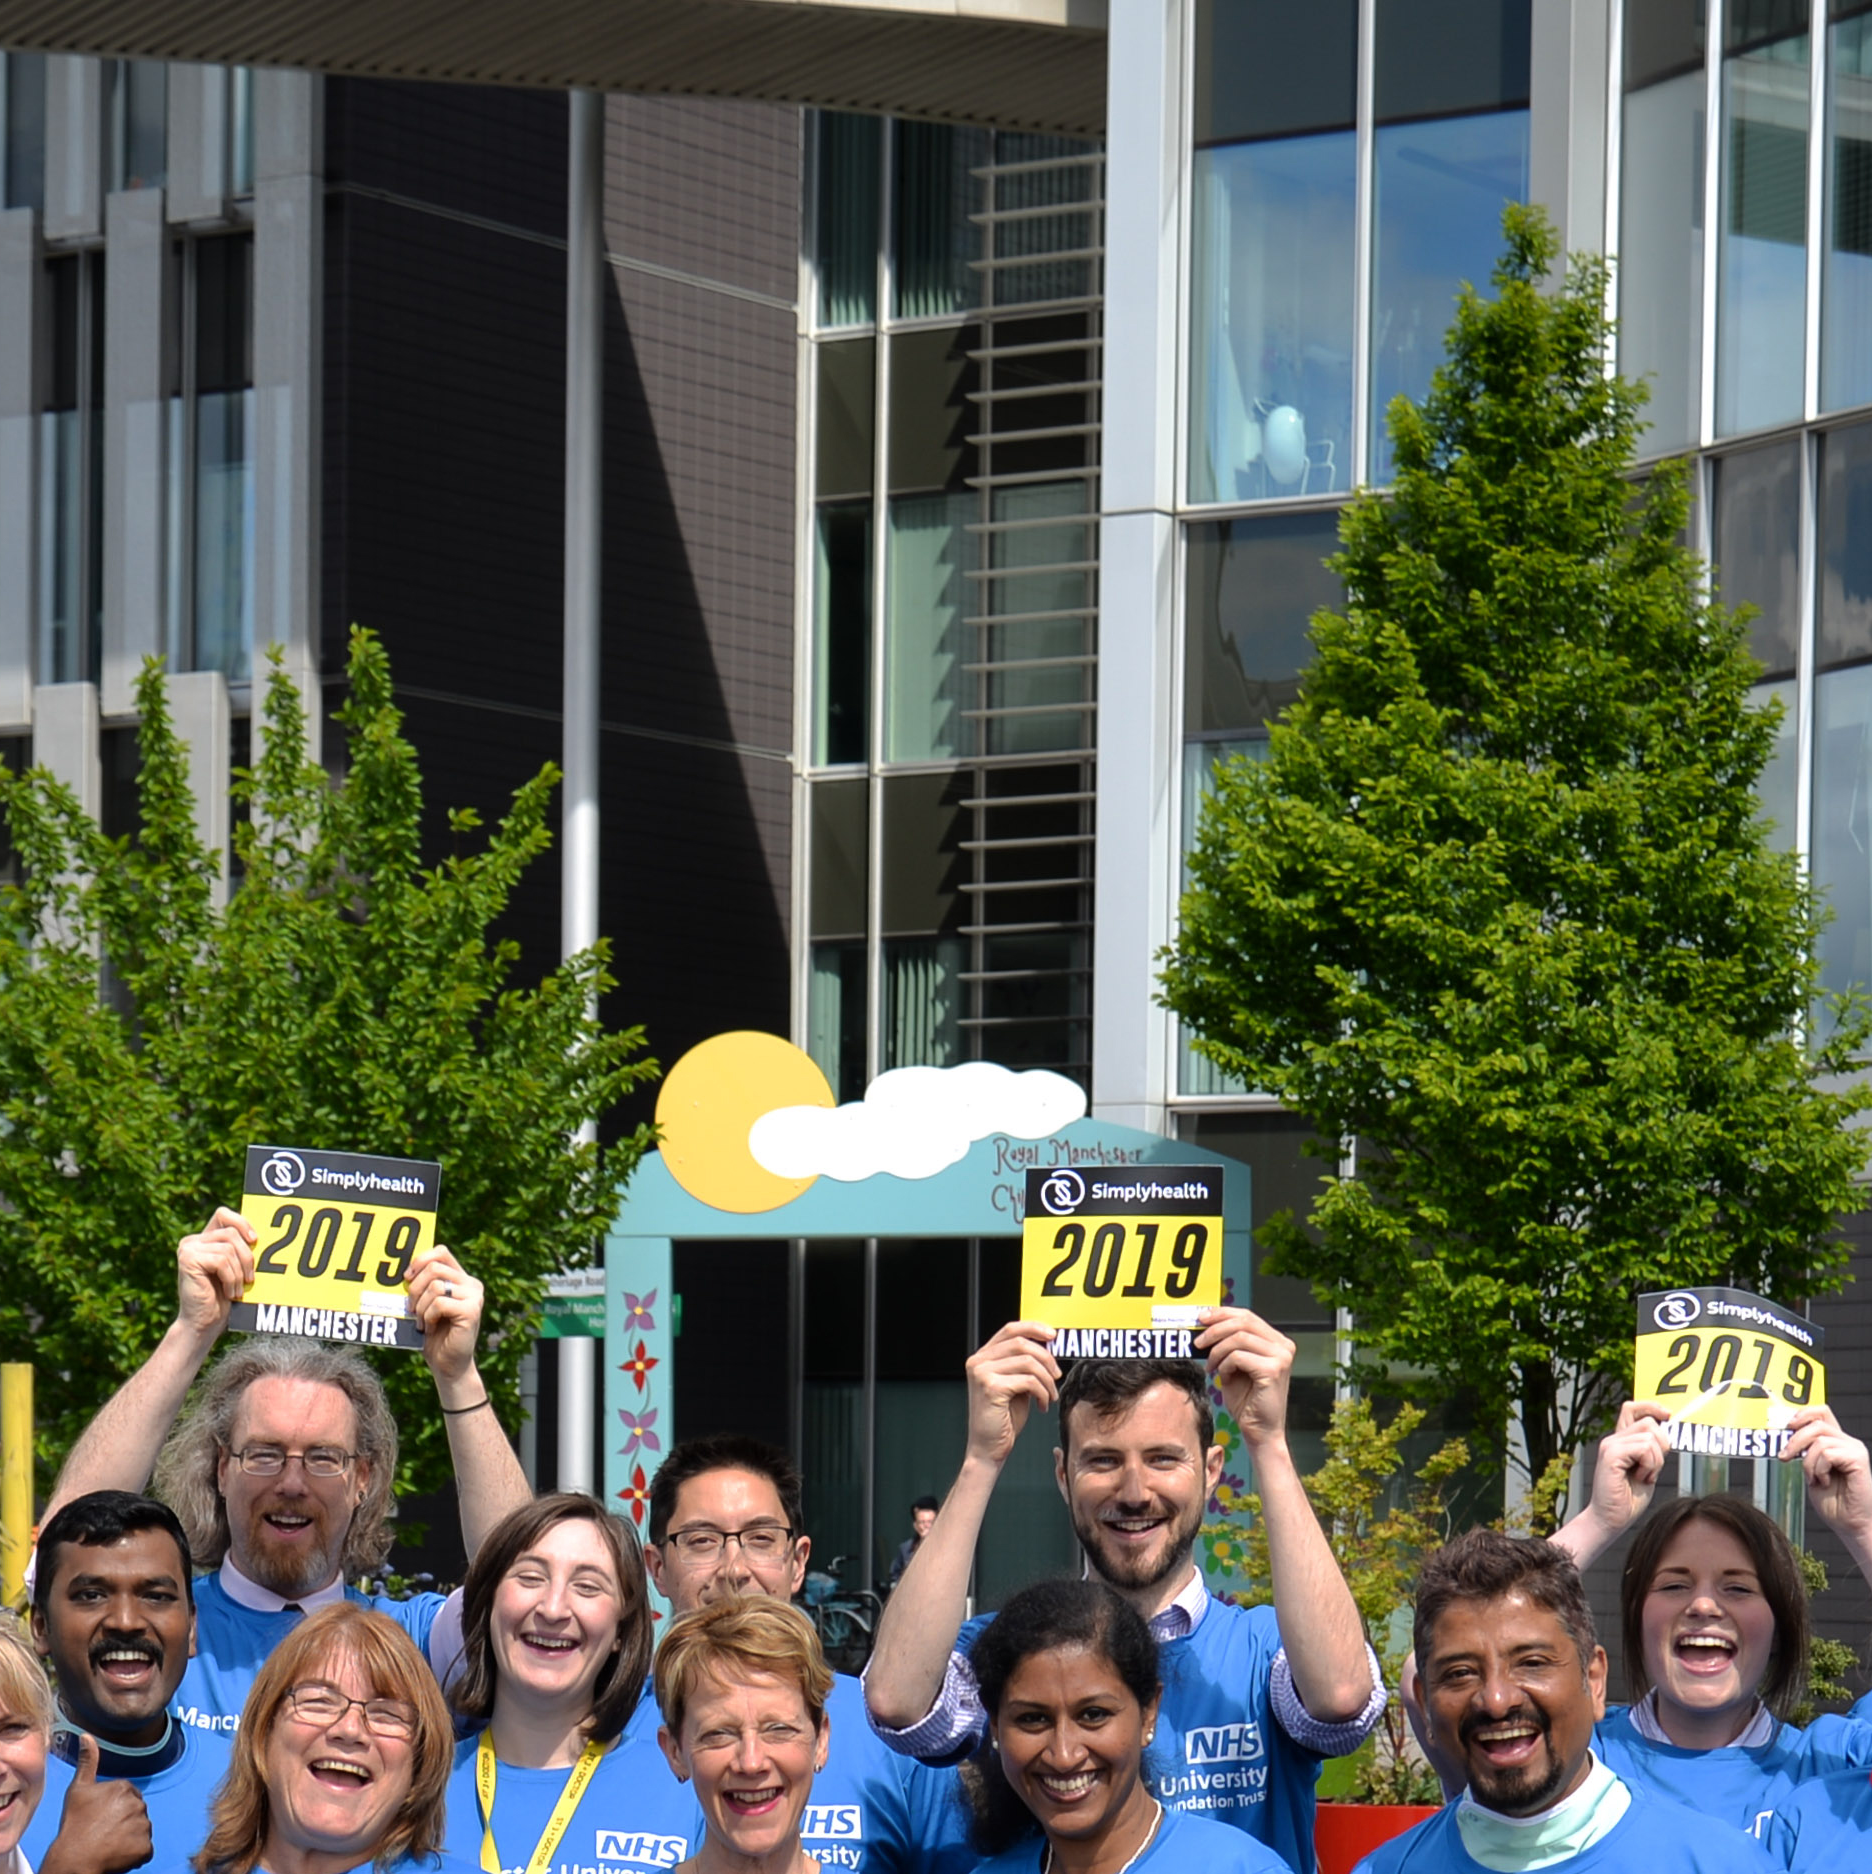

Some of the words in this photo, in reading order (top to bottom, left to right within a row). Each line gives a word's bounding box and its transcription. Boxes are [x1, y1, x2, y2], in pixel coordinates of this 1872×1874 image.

[312, 1168, 425, 1195] Simplyhealth
[1091, 1182, 1209, 1203] Simplyhealth
[255, 1204, 422, 1287] 2019
[1040, 1222, 1209, 1299] 2019
[256, 1303, 398, 1345] MANCHESTER
[1706, 1301, 1814, 1347] Simplyhealth
[1655, 1334, 1815, 1406] 2019
[1189, 1725, 1262, 1760] NHS
[1160, 1766, 1268, 1797] University
[601, 1834, 683, 1863] NHS
